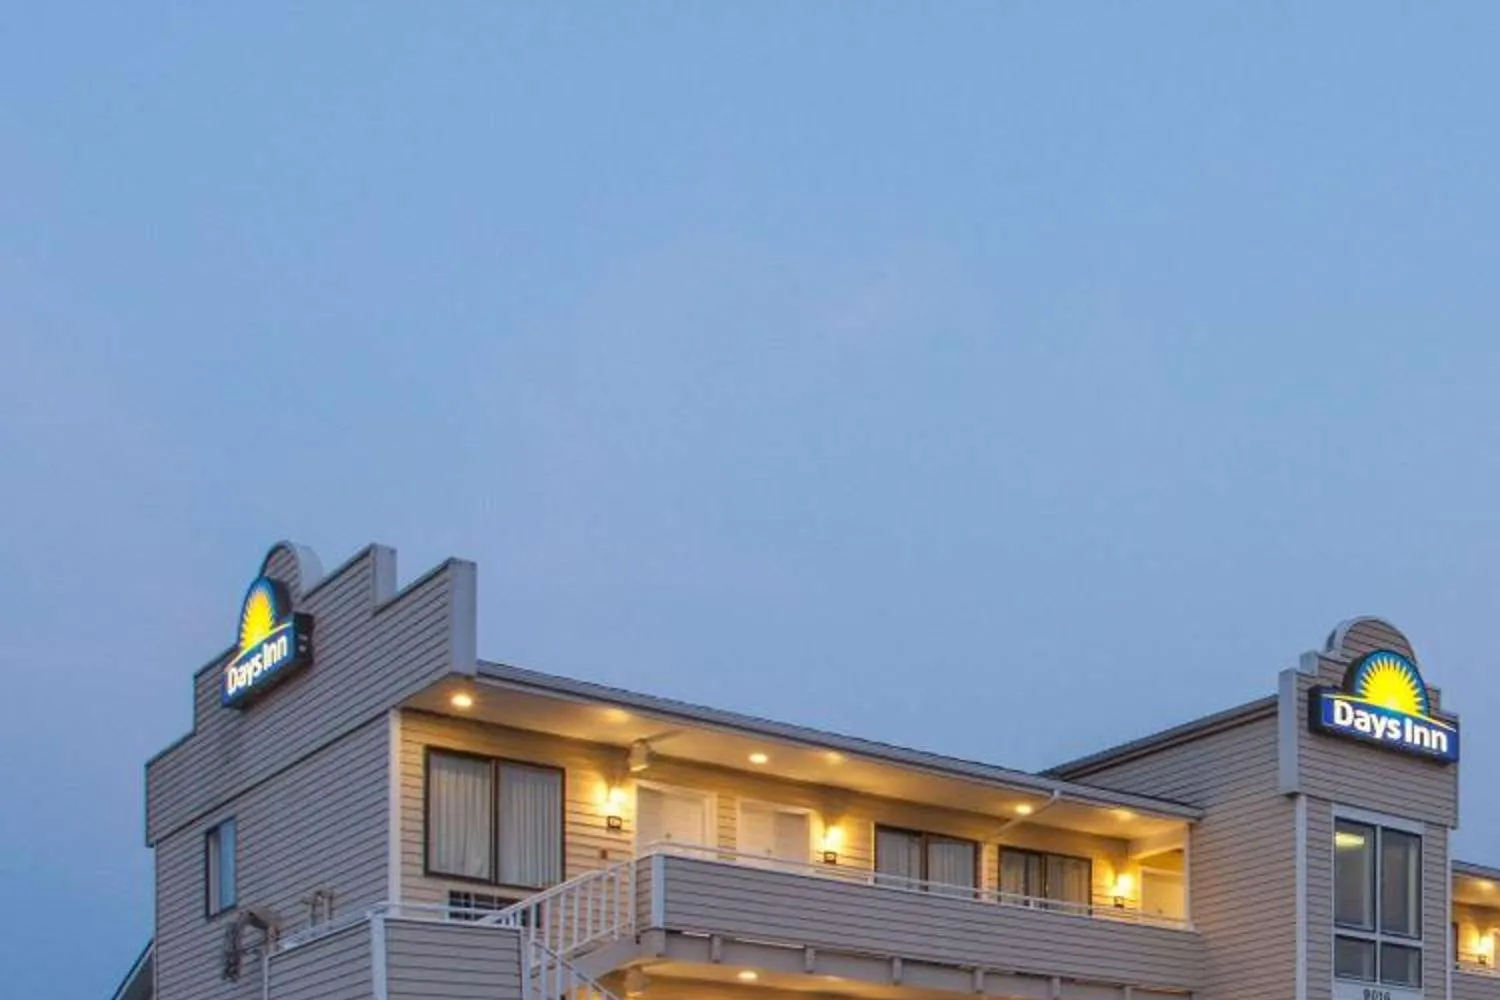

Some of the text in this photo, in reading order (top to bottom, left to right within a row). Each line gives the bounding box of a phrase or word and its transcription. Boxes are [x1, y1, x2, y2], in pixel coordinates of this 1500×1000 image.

[227, 635, 288, 697] Days Inn
[1333, 699, 1448, 753] Days Inn
